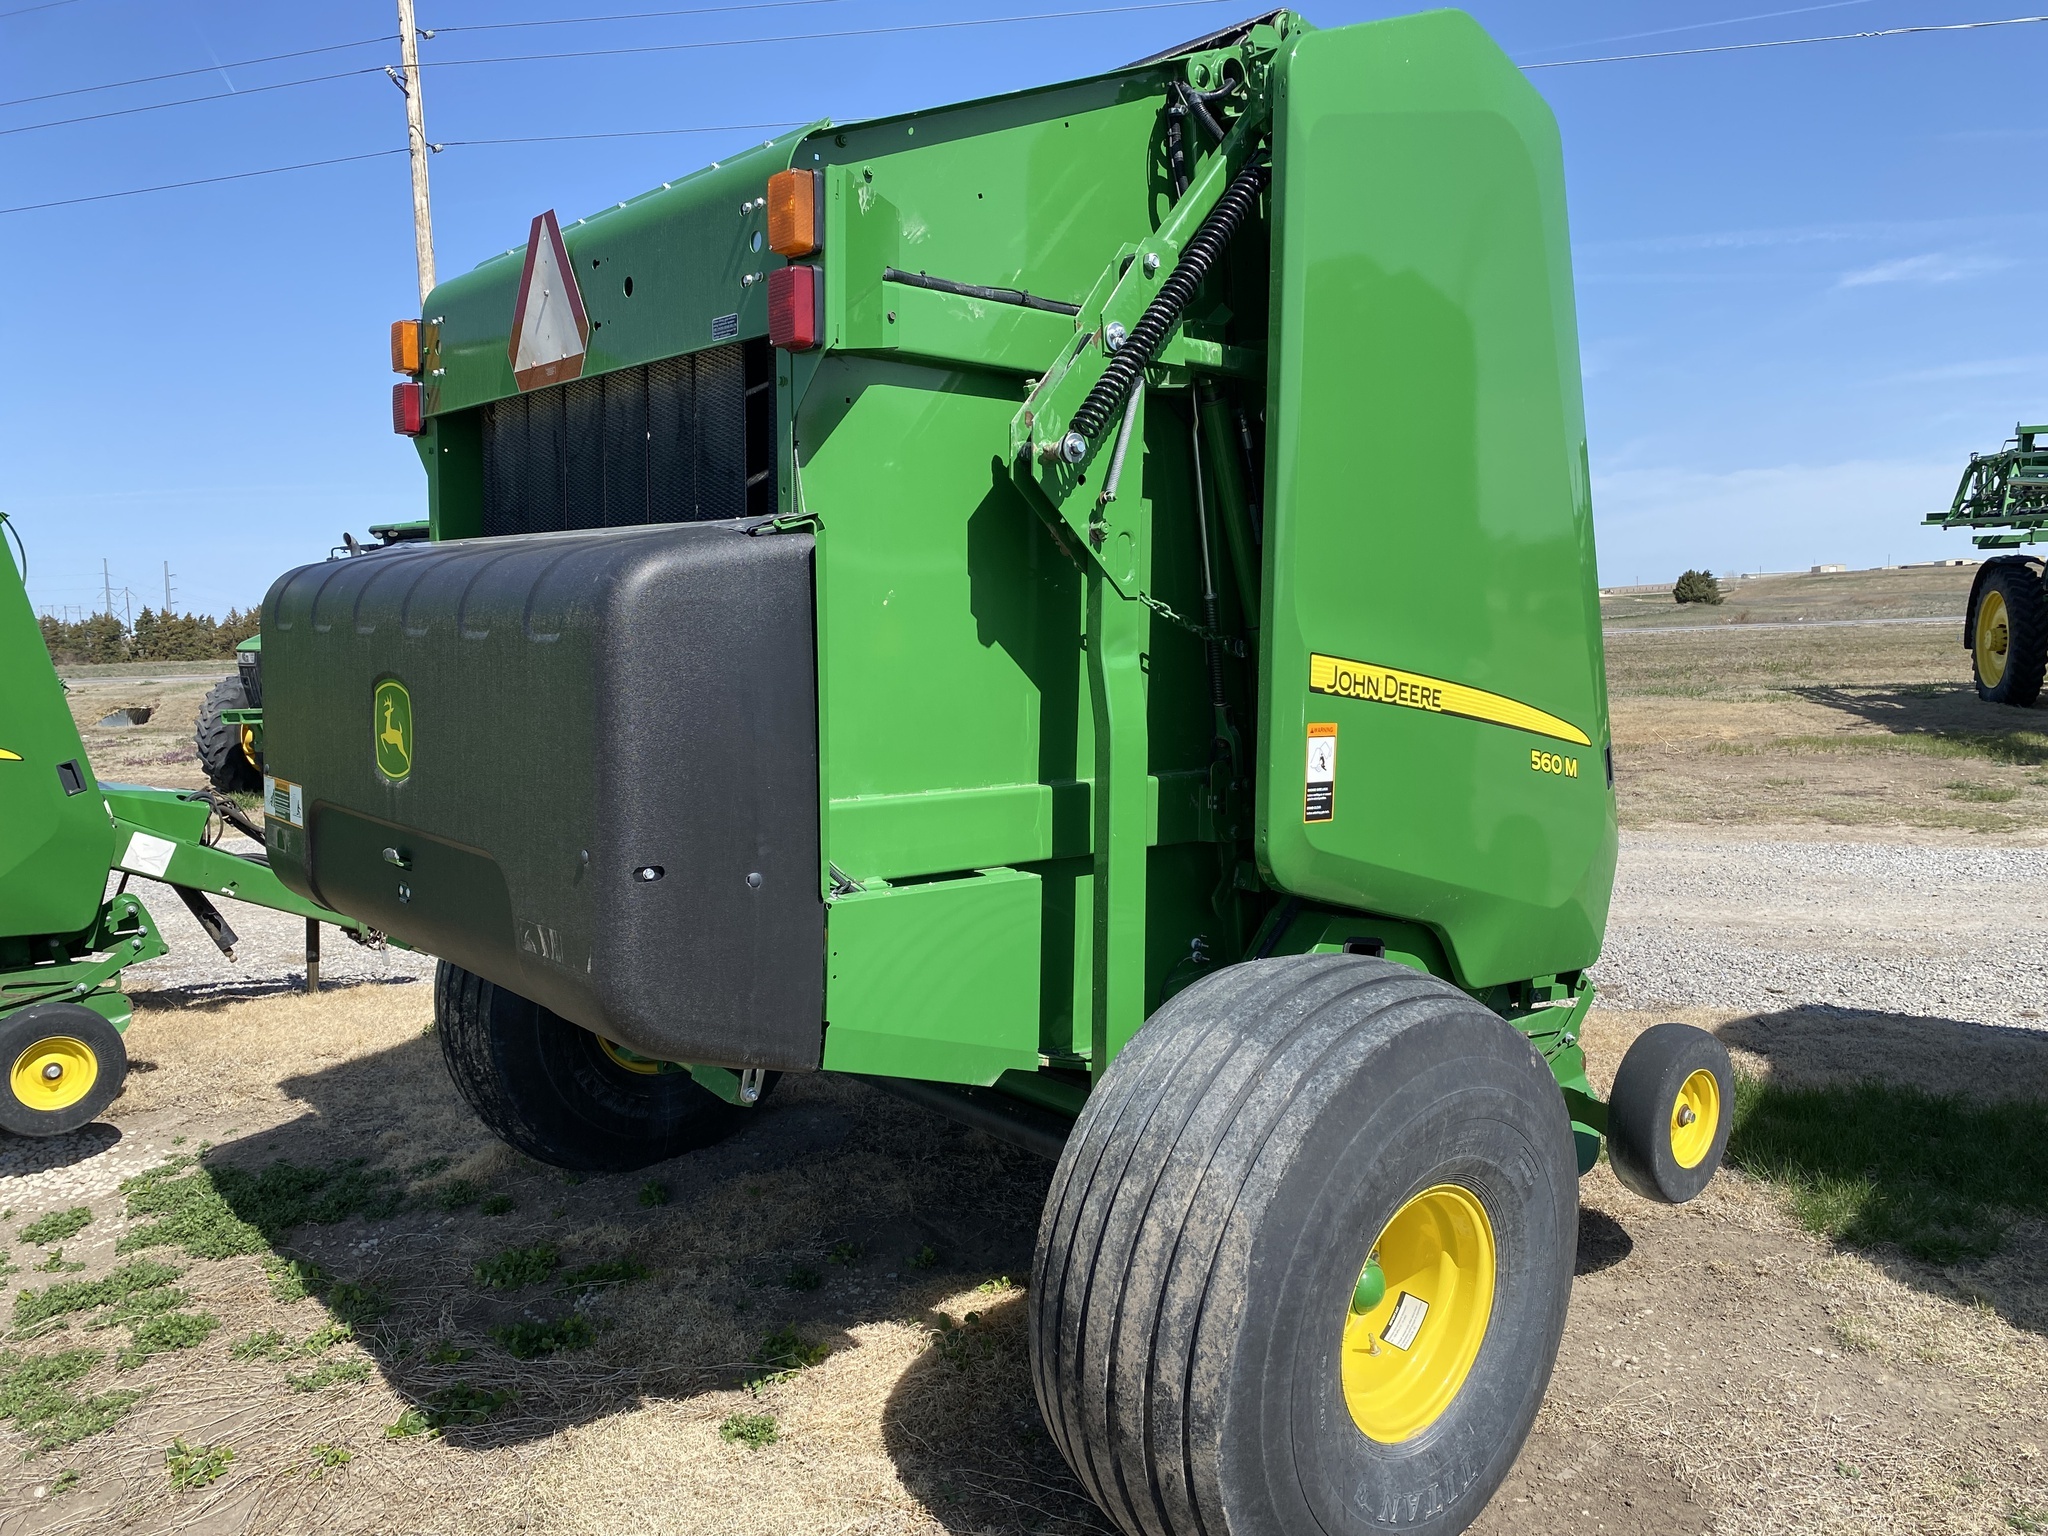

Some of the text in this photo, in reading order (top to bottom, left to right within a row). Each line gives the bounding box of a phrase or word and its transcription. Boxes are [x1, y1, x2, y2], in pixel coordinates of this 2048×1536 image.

[1326, 665, 1442, 708] JOHN DEERE
[1531, 749, 1578, 779] 560 M
[1376, 1453, 1478, 1524] TITAN
